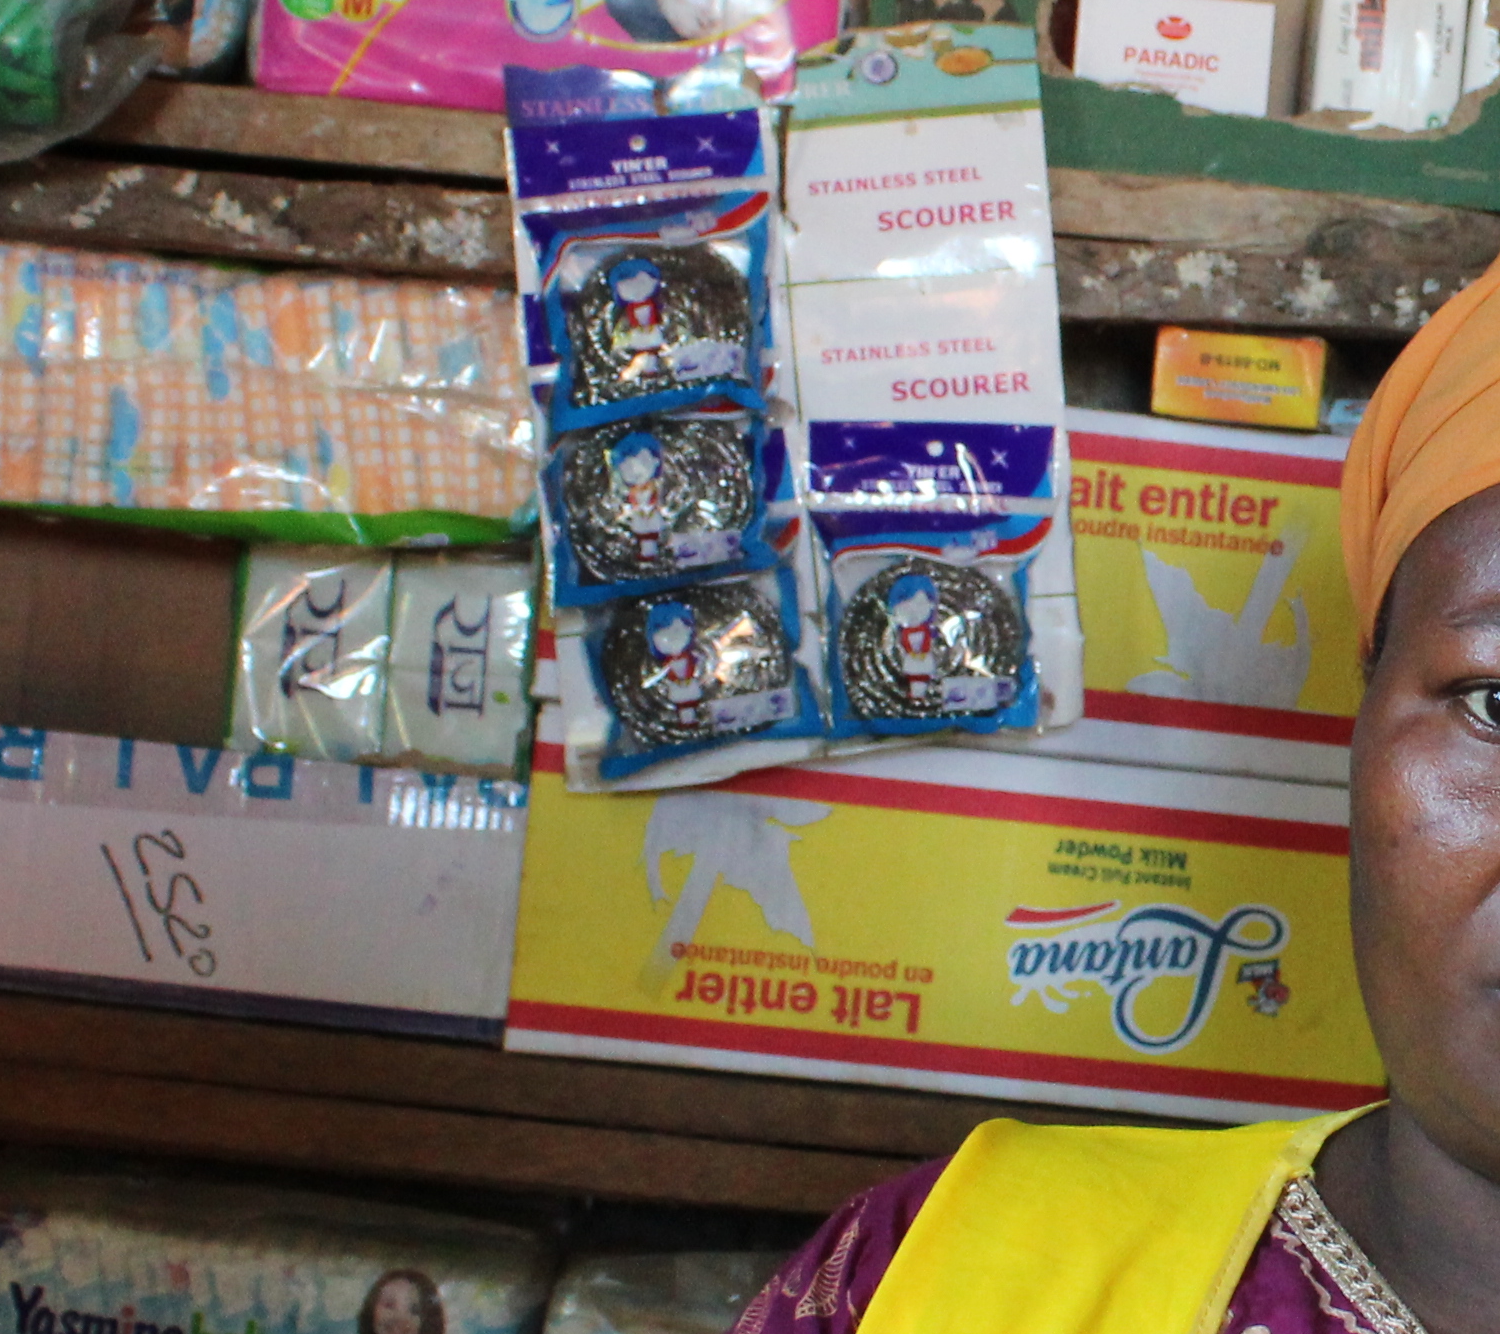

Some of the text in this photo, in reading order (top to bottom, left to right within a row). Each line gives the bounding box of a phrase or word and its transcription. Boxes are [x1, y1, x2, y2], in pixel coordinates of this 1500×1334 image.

[1123, 46, 1221, 74] PARADIC
[809, 167, 983, 196] STAINLESS STEEL
[878, 201, 1017, 232] SCOURER
[822, 338, 997, 365] STAINLESS STEEL
[892, 372, 1031, 402] SCOURER
[1069, 475, 1278, 529] ait entier
[1070, 519, 1285, 556] oudre instantanée
[1055, 839, 1187, 870] Milk Powder
[1048, 861, 1098, 881] Cream
[670, 942, 934, 984] en poudre instantanée
[1012, 907, 1284, 1049] Lantana
[675, 968, 921, 1035] Lait entier
